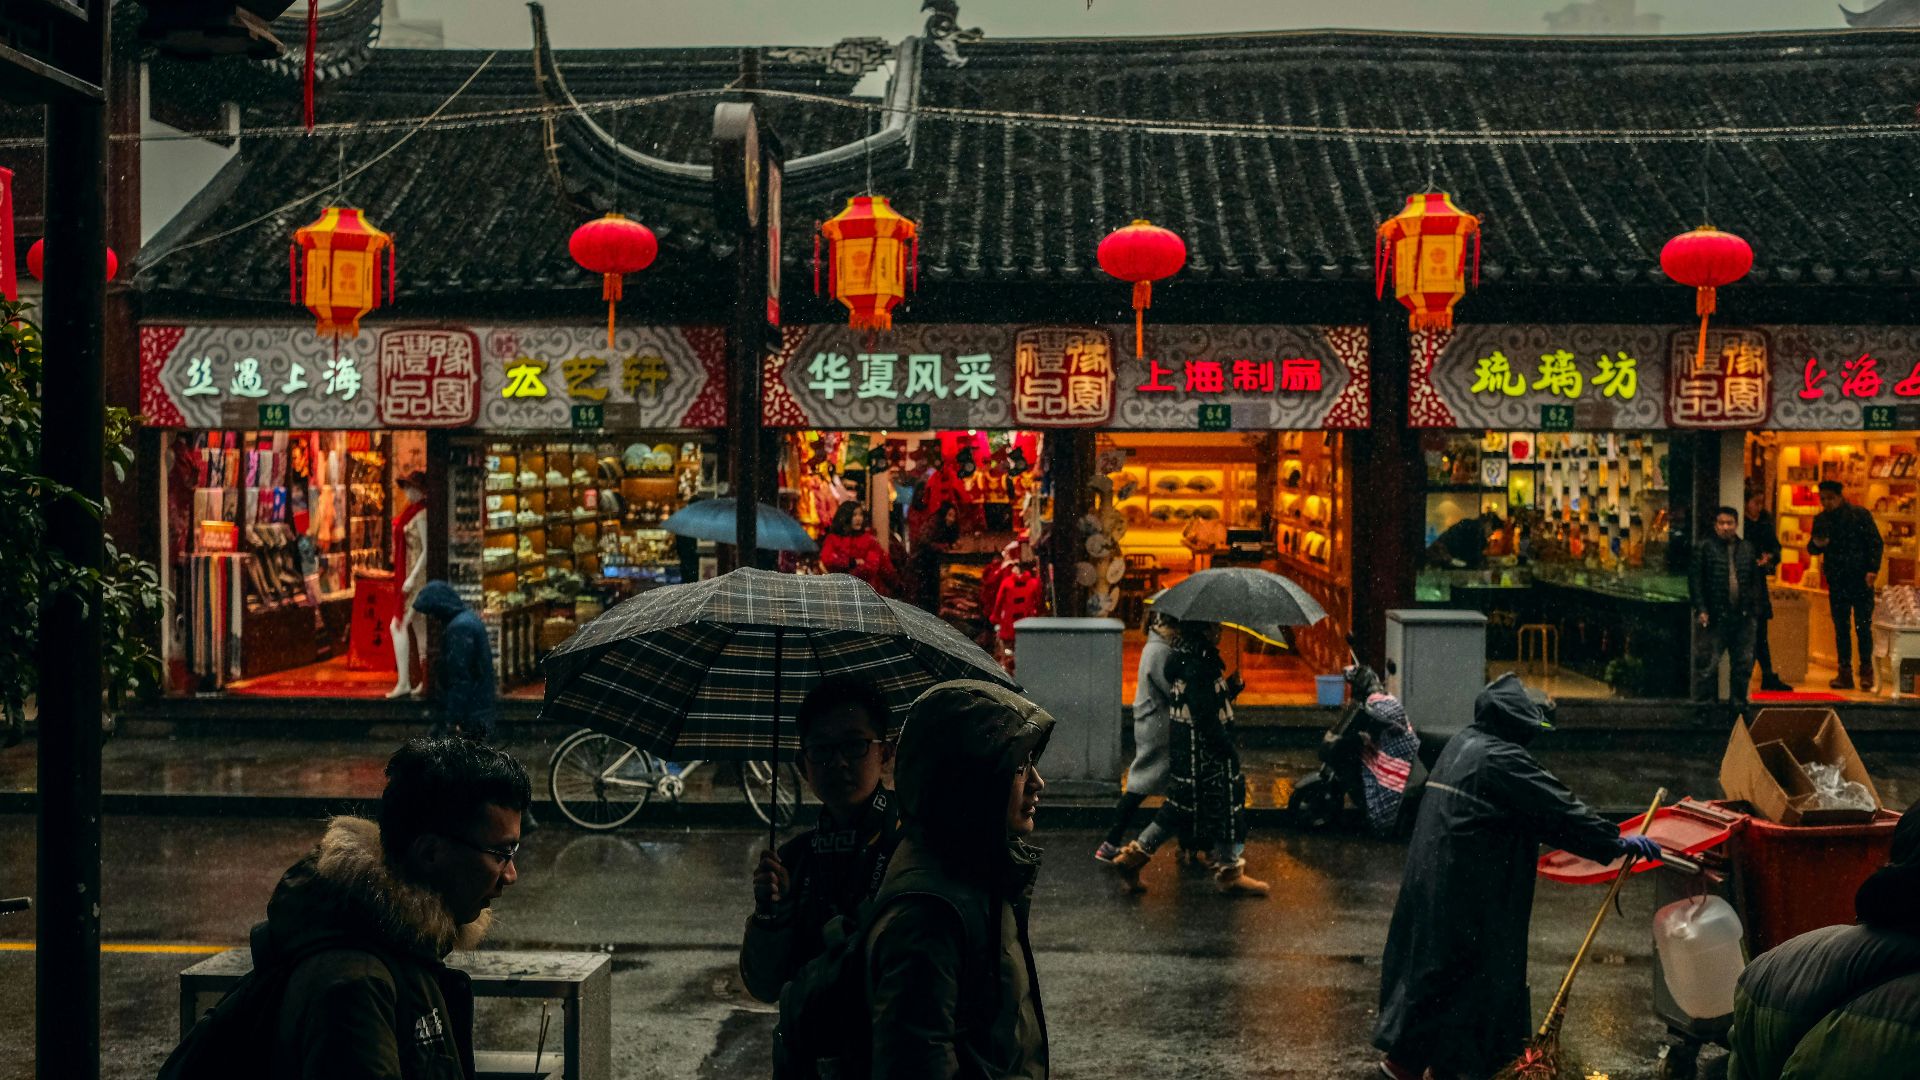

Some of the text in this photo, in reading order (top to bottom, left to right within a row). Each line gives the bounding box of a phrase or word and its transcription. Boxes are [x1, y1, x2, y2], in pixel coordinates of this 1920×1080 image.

[182, 355, 362, 401] 丝遇上海
[807, 352, 997, 400] 华夏风采
[1136, 358, 1322, 393] 上海制扇
[1470, 349, 1638, 399] 琉璃坊
[266, 406, 283, 420] 66
[578, 406, 596, 420] 66
[905, 406, 922, 420] 64
[1205, 406, 1223, 420] 64
[1548, 407, 1566, 421] 62
[1871, 408, 1889, 422] 62
[870, 852, 886, 890] SONY
